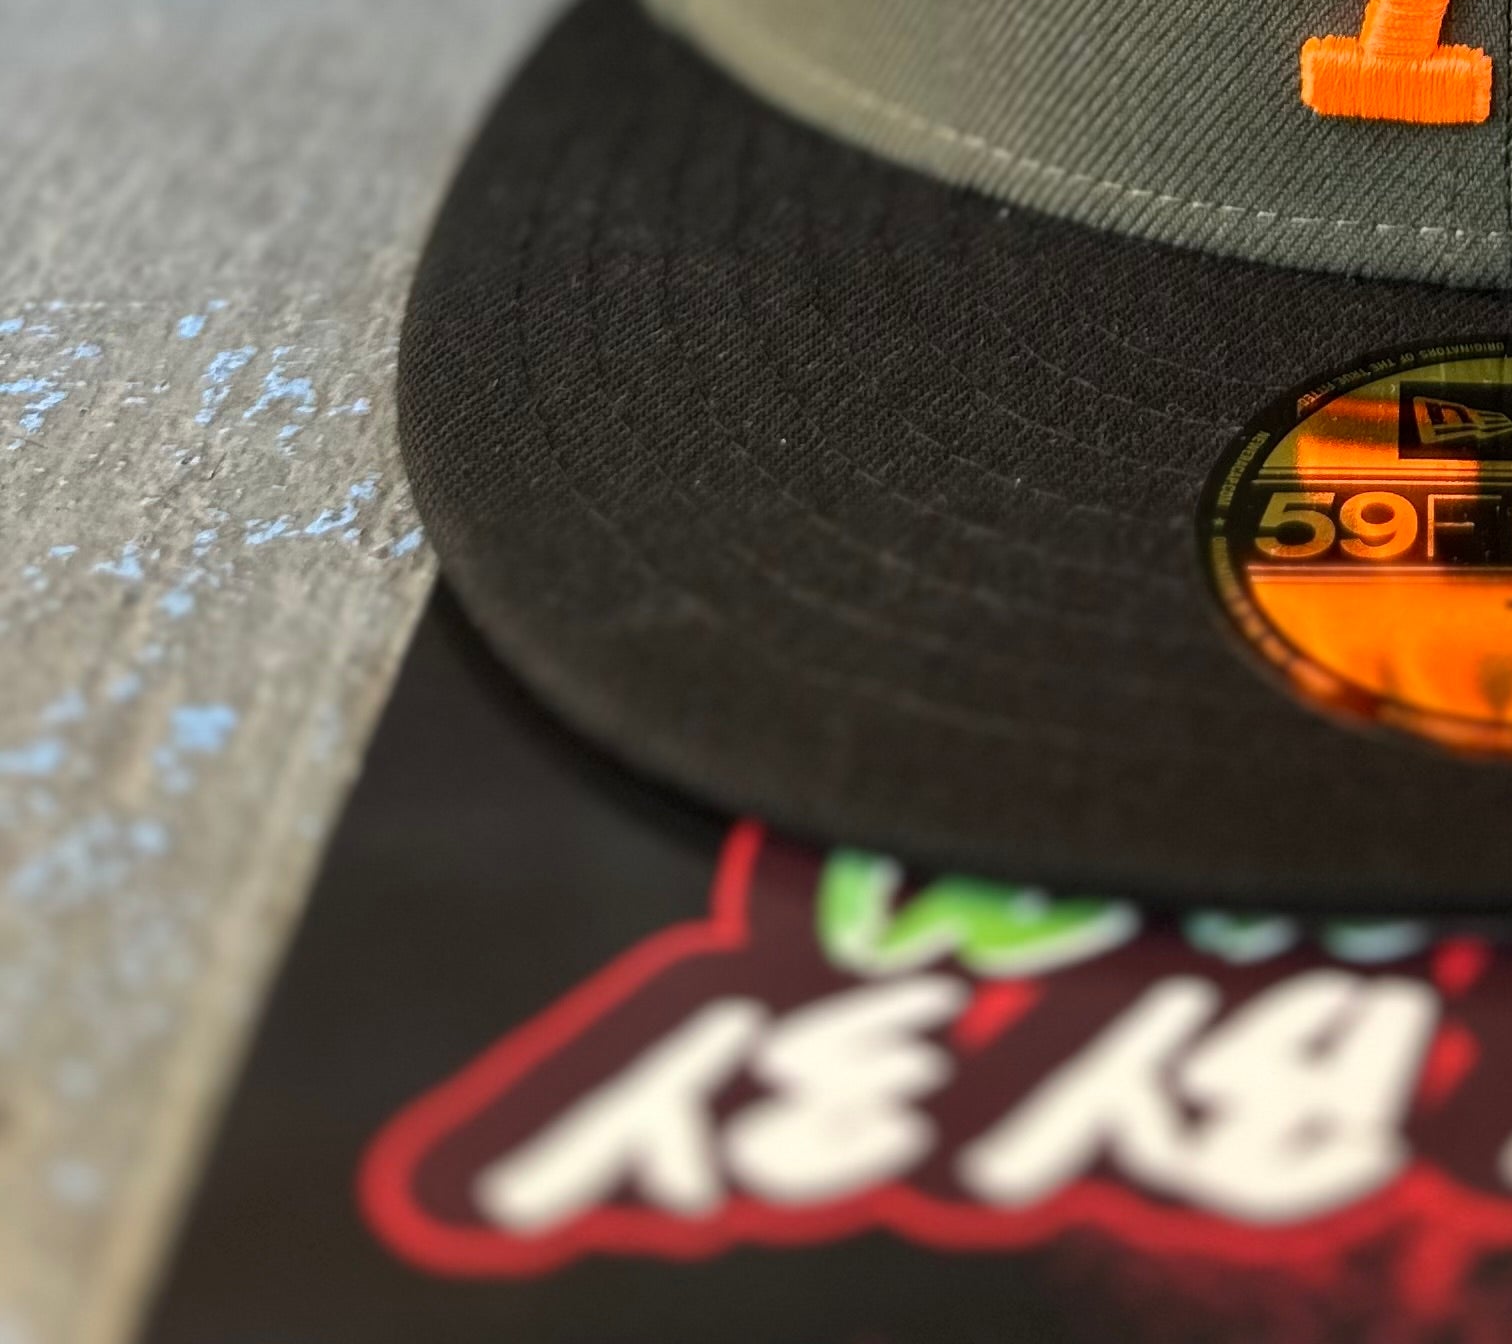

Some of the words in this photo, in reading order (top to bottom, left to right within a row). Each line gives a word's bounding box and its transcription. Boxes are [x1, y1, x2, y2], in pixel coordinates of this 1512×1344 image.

[1418, 340, 1506, 360] ORIGINATORS
[1372, 356, 1397, 374] THE
[1335, 366, 1371, 386] TRUE
[957, 964, 1443, 1226] BY
